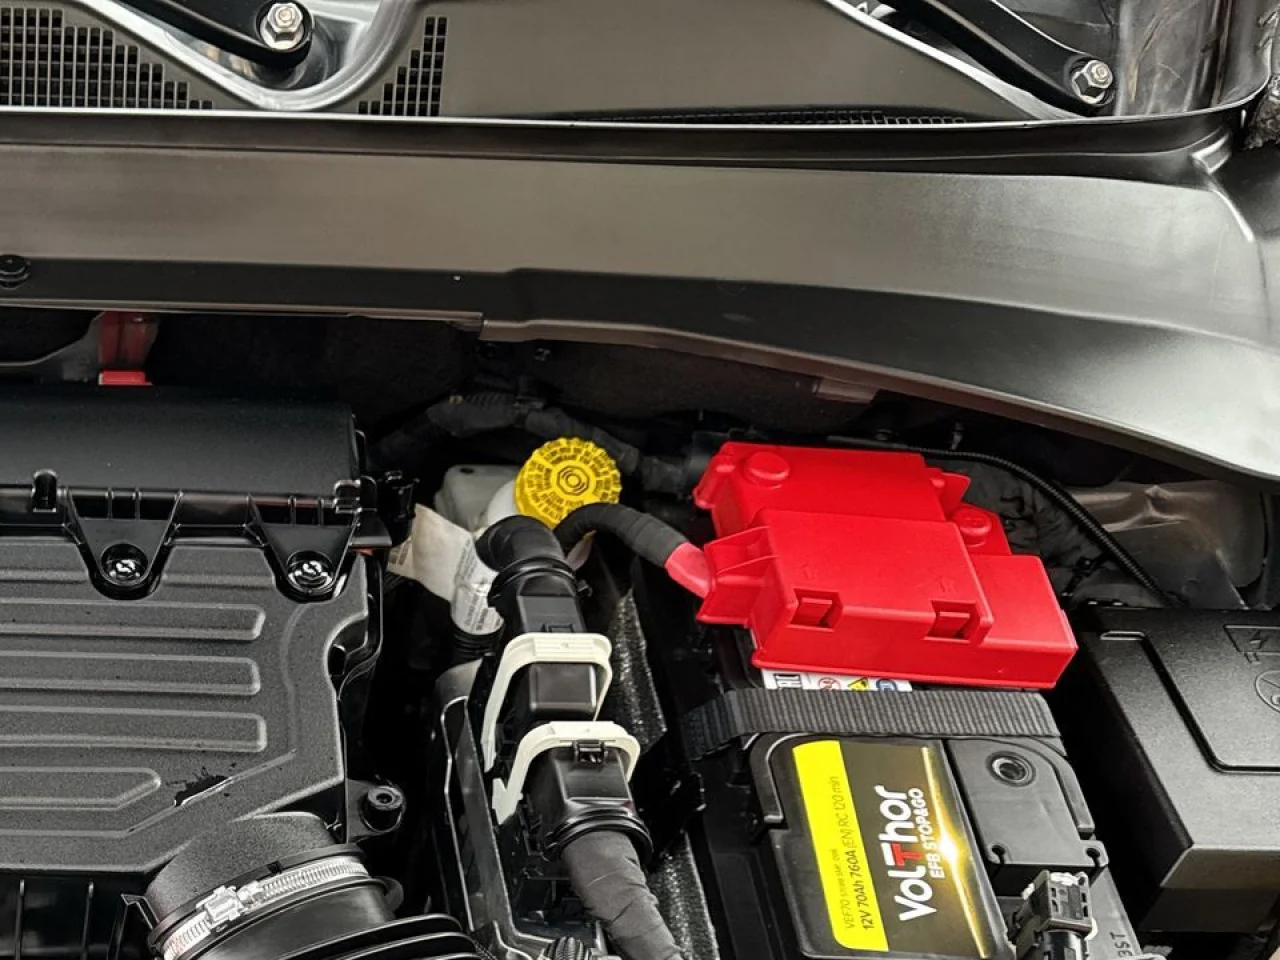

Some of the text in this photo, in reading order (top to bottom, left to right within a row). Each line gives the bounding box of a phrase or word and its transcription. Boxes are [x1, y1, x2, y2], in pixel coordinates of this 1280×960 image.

[844, 850, 862, 878] 760A
[928, 852, 945, 879] EFB
[853, 879, 870, 907] 70Ah
[862, 911, 875, 931] 12V
